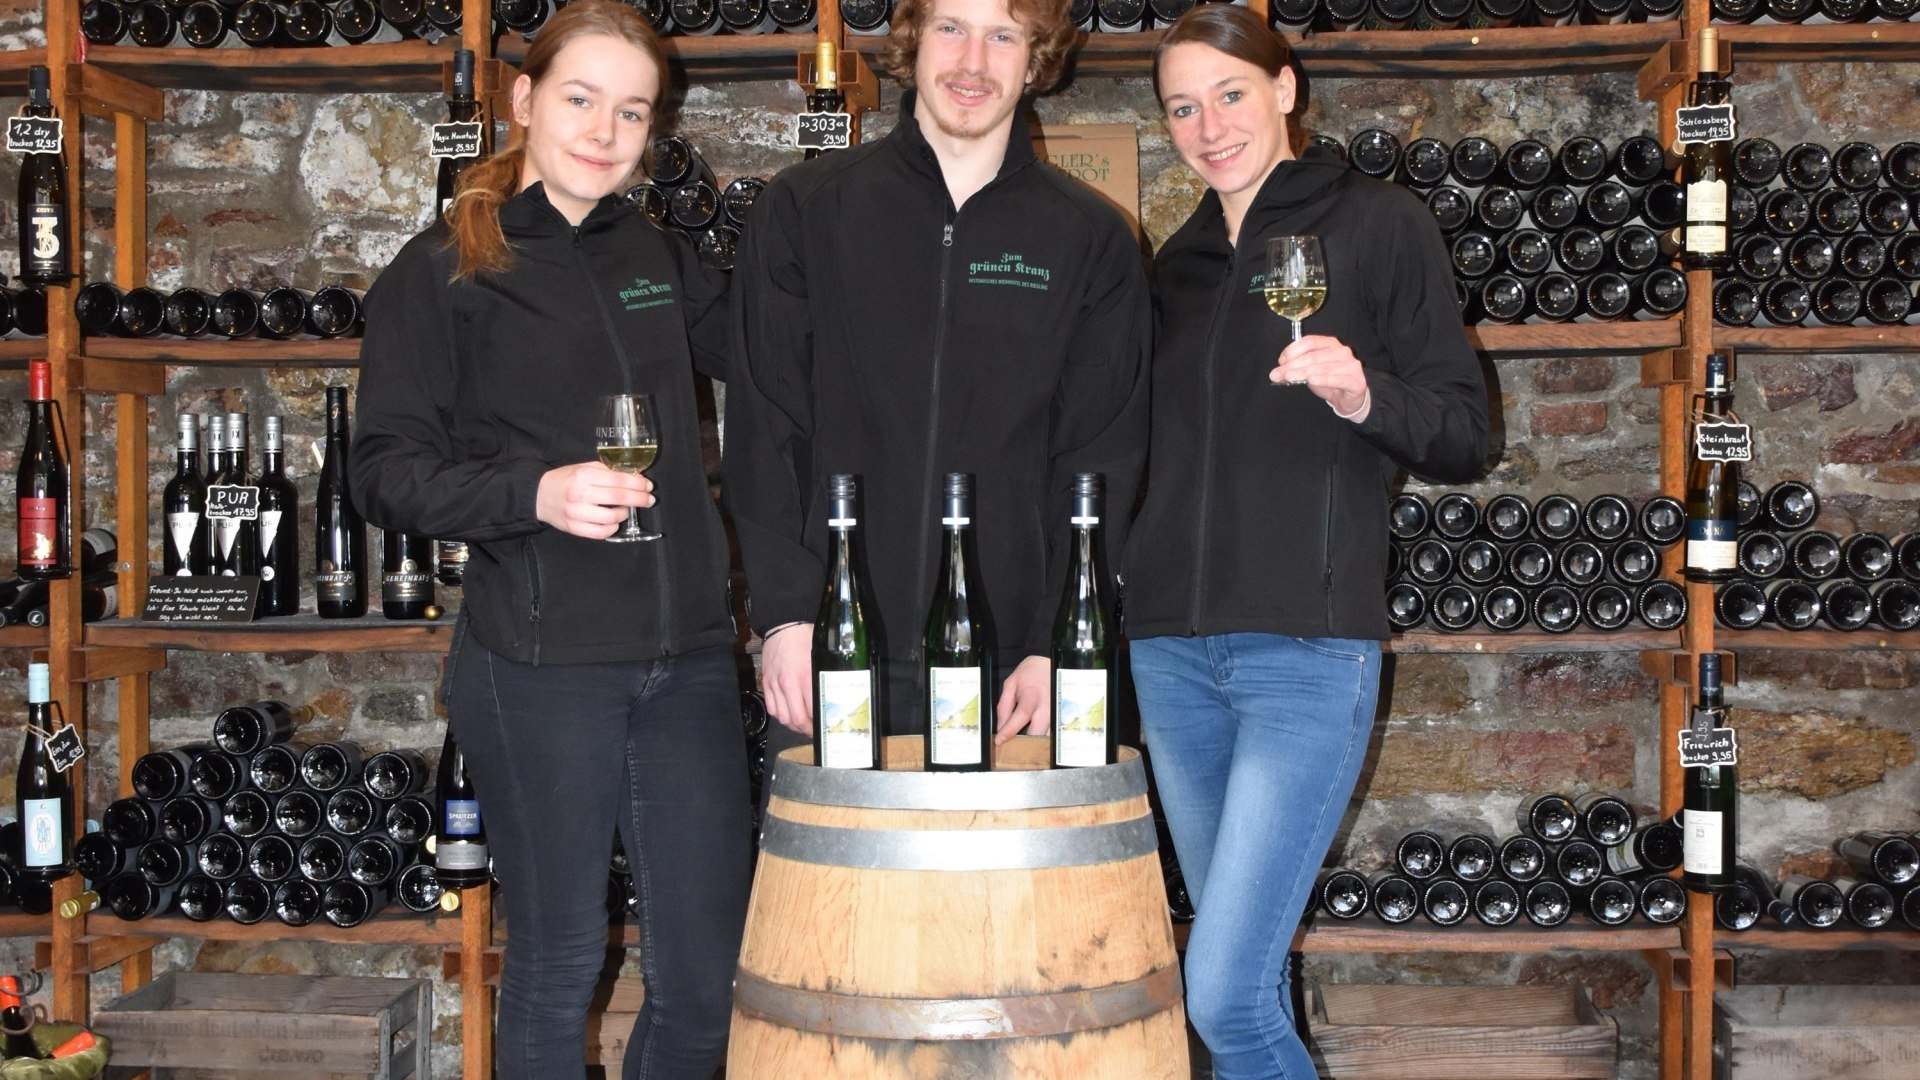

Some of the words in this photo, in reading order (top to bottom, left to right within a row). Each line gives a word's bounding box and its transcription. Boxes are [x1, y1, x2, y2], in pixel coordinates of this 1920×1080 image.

[1679, 116, 1729, 126] Schlossberg
[13, 123, 32, 136] 1,2
[34, 127, 50, 139] dry
[434, 132, 449, 142] Magic
[451, 131, 477, 140] Mountain
[1681, 130, 1707, 138] trocken
[1708, 126, 1729, 139] 19,95
[9, 138, 34, 147] trocken
[35, 138, 58, 150] 12,95
[432, 145, 453, 154] trocken
[455, 143, 475, 153] 25,95
[1001, 252, 1022, 263] Zum
[969, 261, 1011, 275] grünen
[1015, 262, 1050, 281] Kranz
[619, 287, 650, 303] grünen
[1700, 433, 1745, 444] Steinkraut
[1700, 447, 1723, 455] trocken
[217, 491, 249, 504] PUR
[233, 507, 255, 517] 17,95
[386, 574, 426, 582] GEHEIMRAT
[1683, 753, 1709, 761] trocken
[1712, 750, 1732, 762] 9,95
[448, 812, 478, 820] SPREITZER
